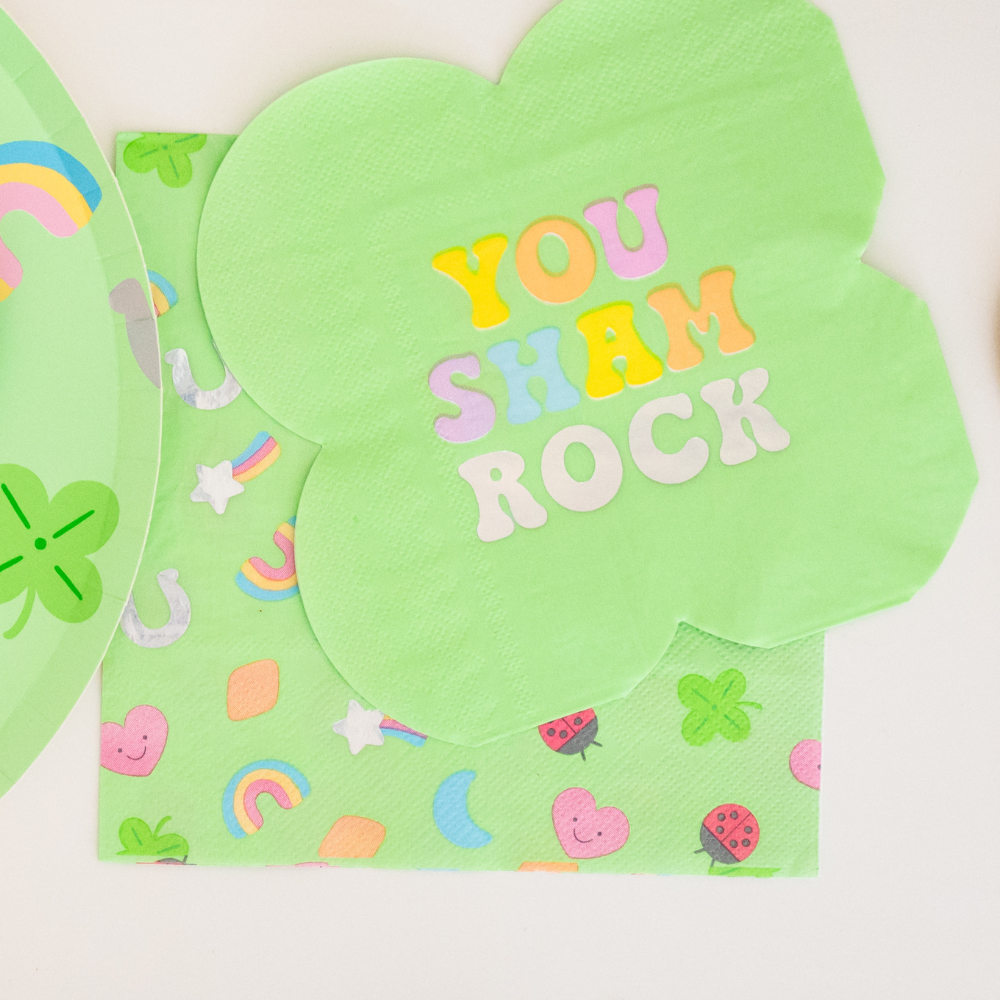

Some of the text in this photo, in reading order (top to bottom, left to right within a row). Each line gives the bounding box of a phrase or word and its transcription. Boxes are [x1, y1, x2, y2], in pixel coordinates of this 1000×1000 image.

[431, 183, 669, 330] YOU
[427, 265, 757, 444] SHAM
[457, 367, 791, 542] ROCK
